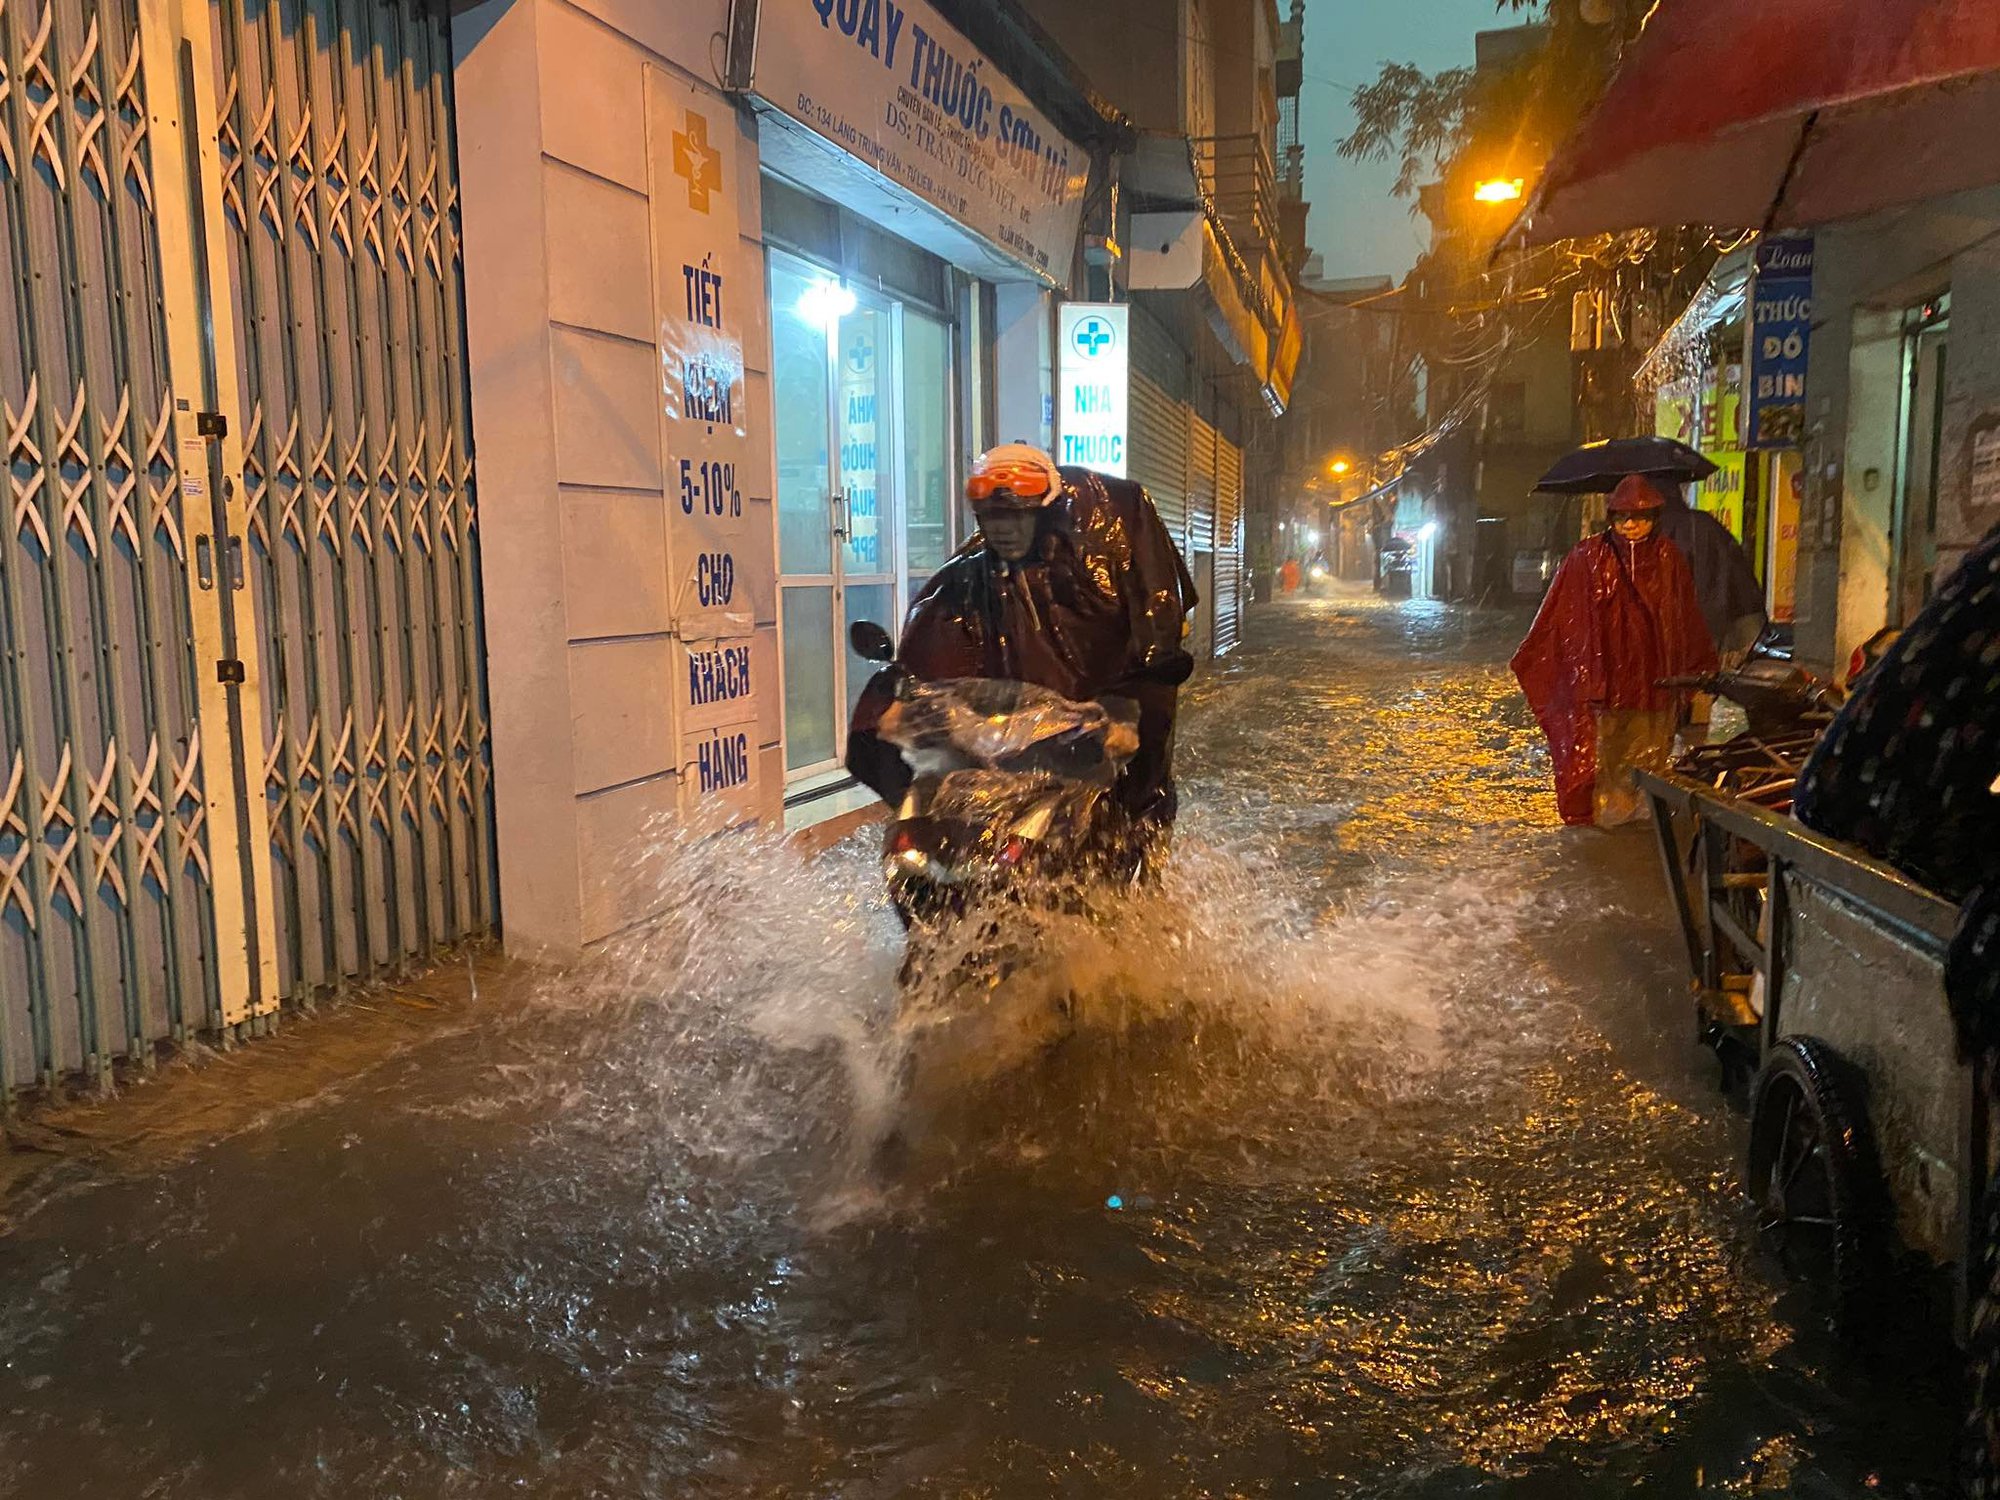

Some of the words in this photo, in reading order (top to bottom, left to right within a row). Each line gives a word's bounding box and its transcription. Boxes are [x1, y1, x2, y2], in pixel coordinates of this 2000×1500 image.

[816, 105, 832, 128] 134
[857, 132, 885, 162] TRUNG
[682, 252, 722, 330] TIẾT
[680, 458, 742, 518] 5-10%
[698, 553, 734, 607] CHO
[689, 638, 751, 706] KHÁCH
